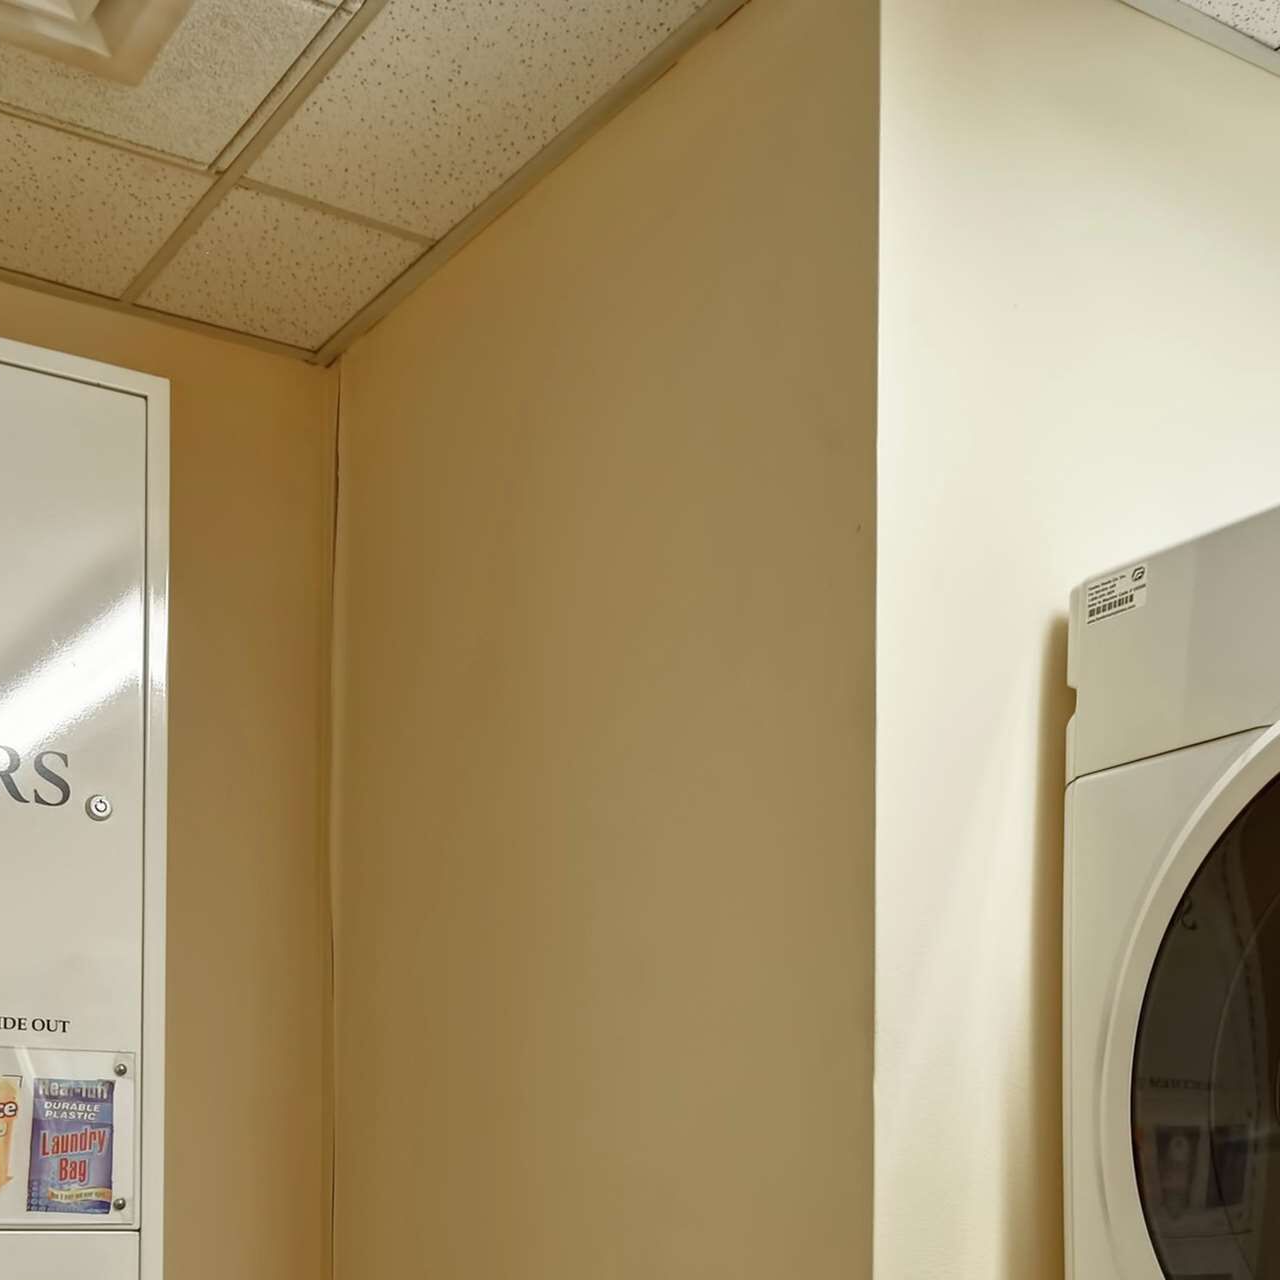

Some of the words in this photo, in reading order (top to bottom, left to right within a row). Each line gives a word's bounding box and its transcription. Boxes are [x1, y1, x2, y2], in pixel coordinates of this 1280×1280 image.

[31, 1017, 71, 1034] OUT
[44, 1101, 101, 1113] DURABLE
[45, 1110, 96, 1121] PLASTIC
[41, 1127, 106, 1156] Laundry
[59, 1158, 87, 1182] Bag
